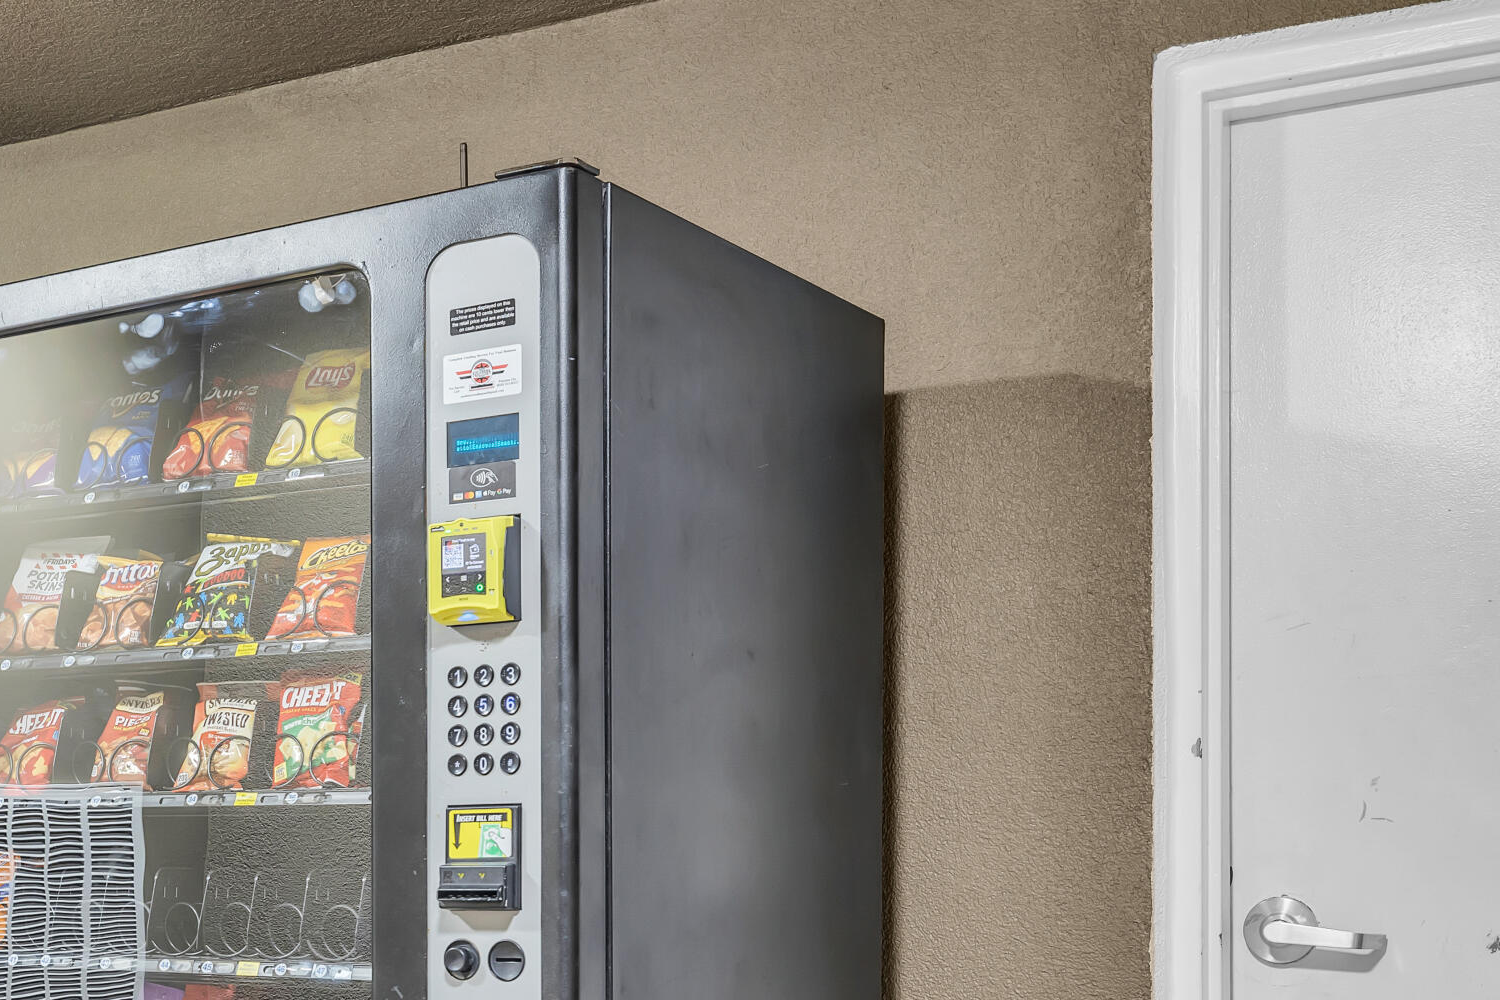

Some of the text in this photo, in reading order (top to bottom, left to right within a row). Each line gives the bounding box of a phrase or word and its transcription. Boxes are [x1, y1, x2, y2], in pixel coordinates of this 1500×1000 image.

[27, 580, 65, 592] SKINS
[454, 667, 515, 683] 1 2 3
[453, 696, 515, 712] 4 5 6
[453, 725, 515, 743] 7 8 9
[479, 756, 487, 770] 0
[455, 814, 503, 823] INSERT BILL HERE
[276, 964, 285, 972] 46
